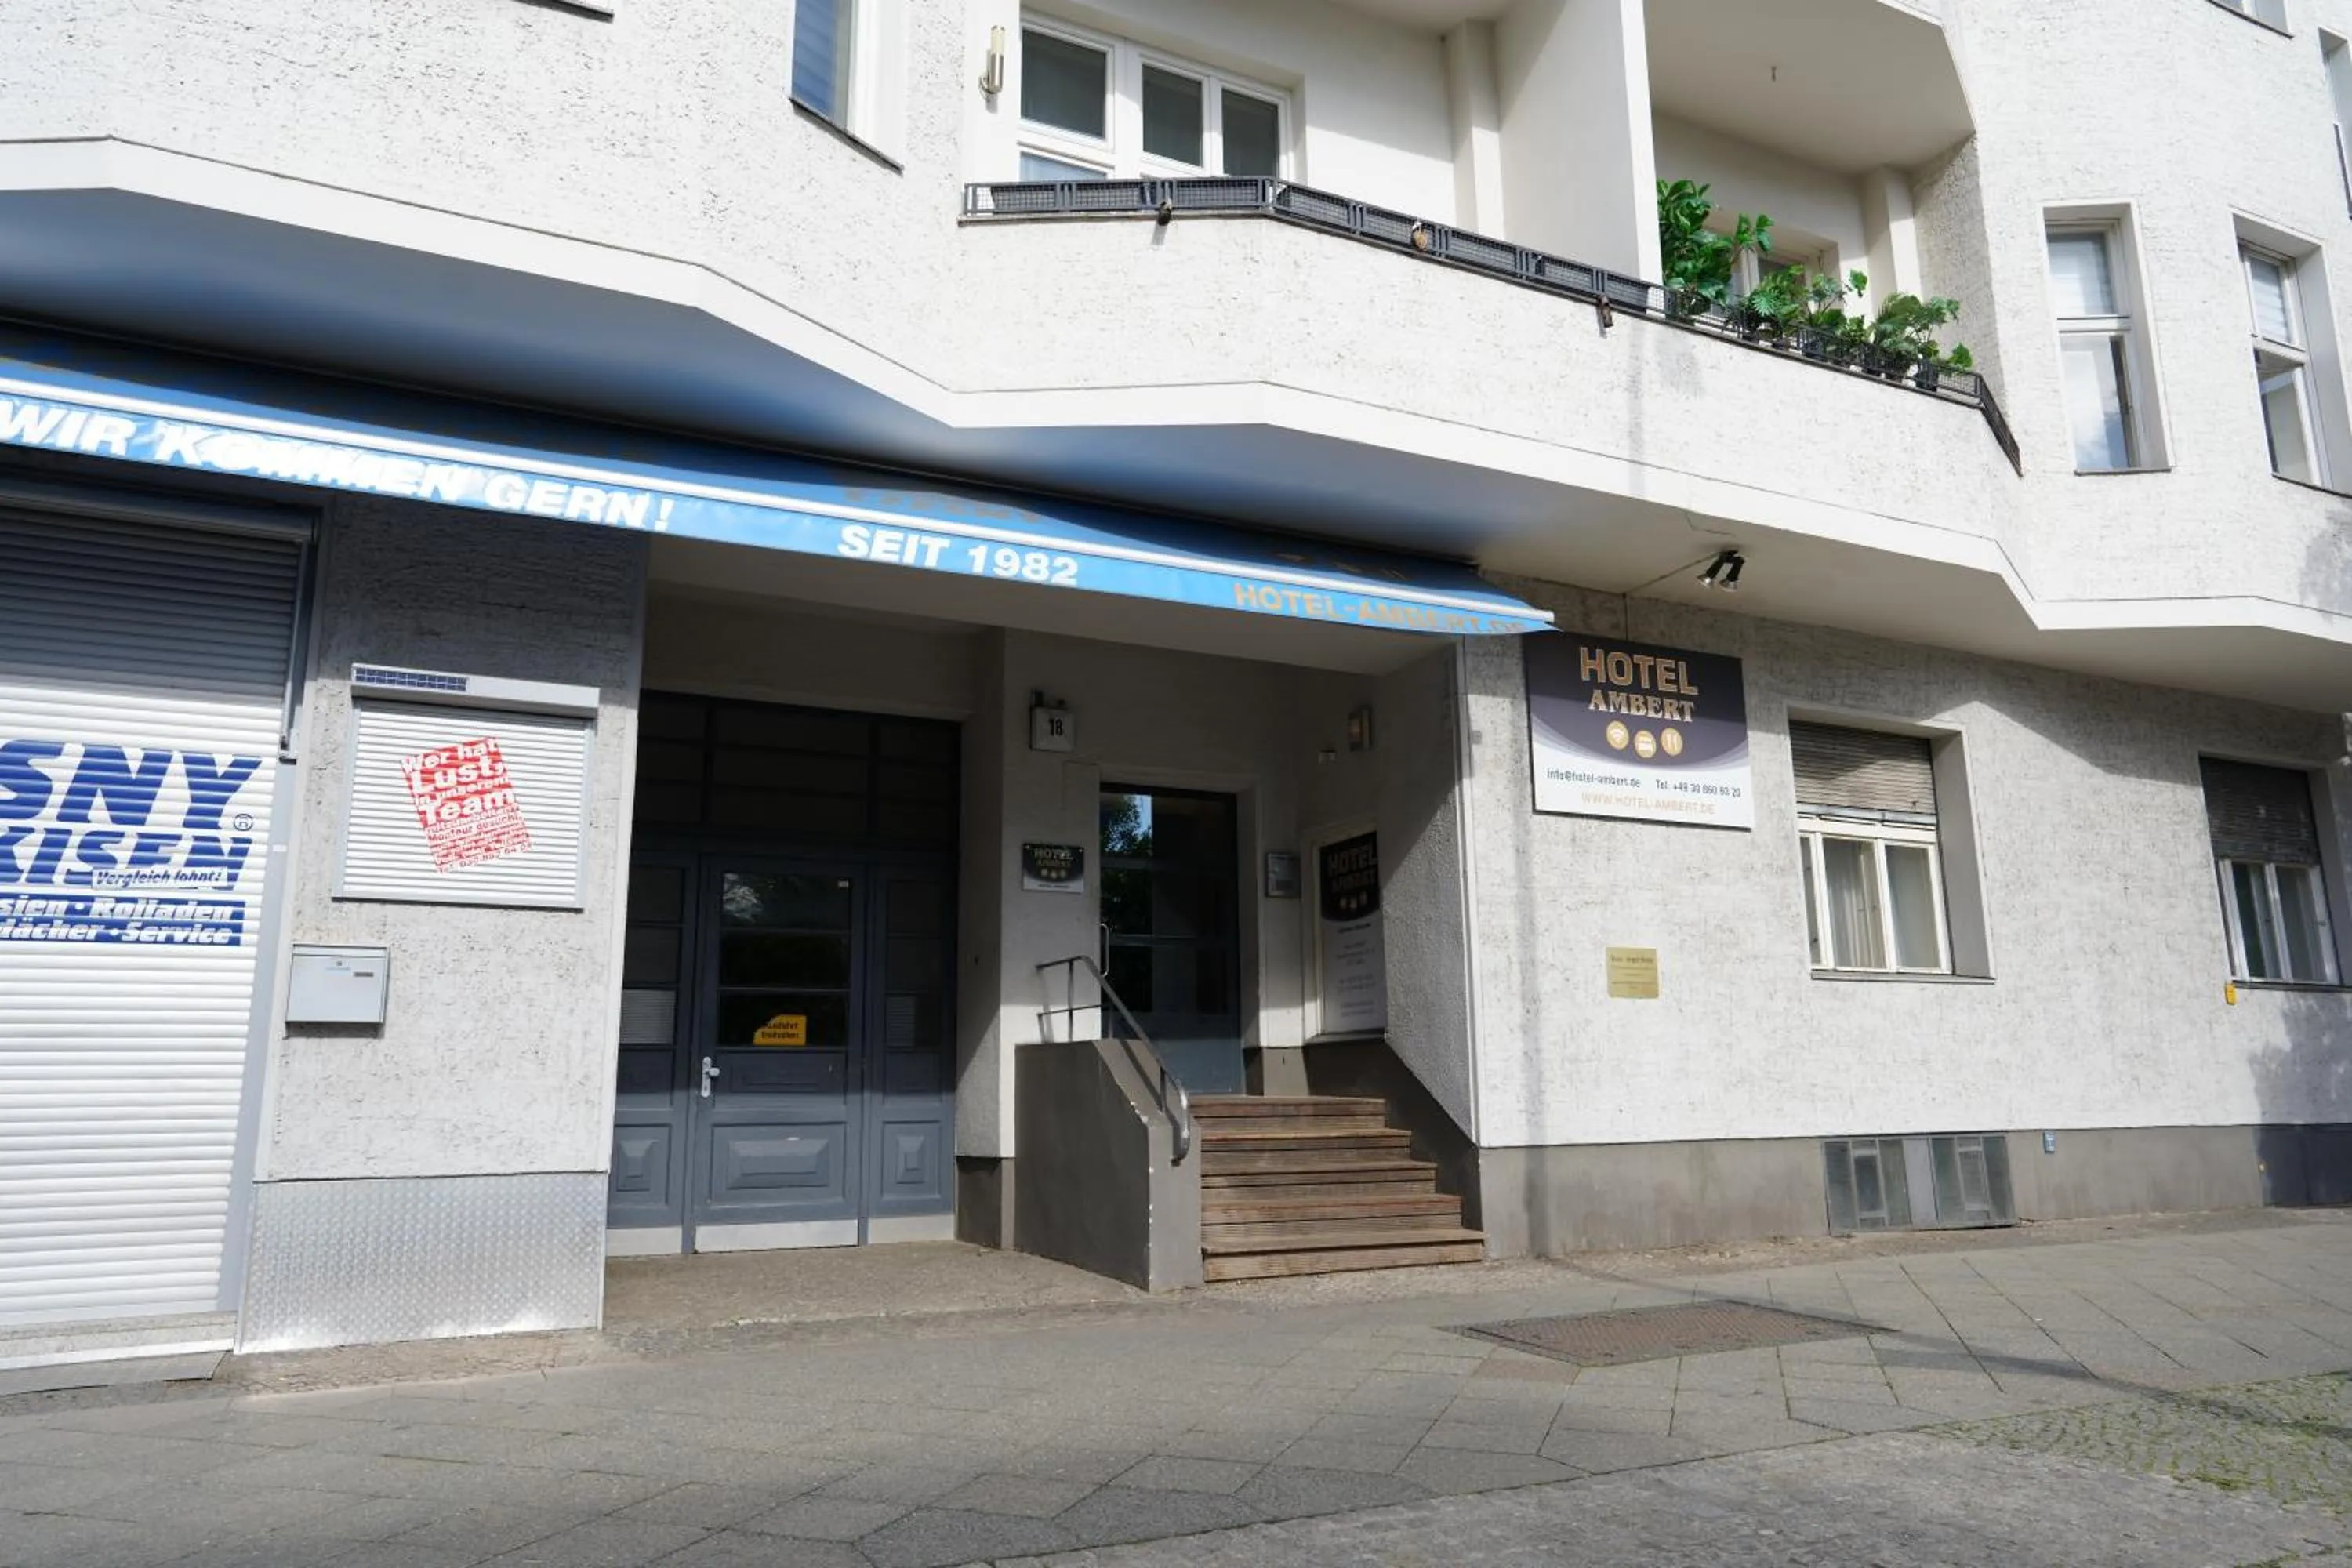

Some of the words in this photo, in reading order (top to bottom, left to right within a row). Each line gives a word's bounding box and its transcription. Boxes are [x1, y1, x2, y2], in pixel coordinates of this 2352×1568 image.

[0, 401, 136, 456] WIR
[837, 524, 950, 568] SEIT
[967, 545, 1078, 586] 1982
[1580, 646, 1699, 695] HOTEL
[1587, 689, 1693, 723] AMBERT
[1048, 717, 1063, 736] 18
[401, 750, 455, 774] Wer
[456, 738, 501, 758] hat
[0, 739, 263, 830] SNY
[410, 756, 507, 794] Lust,
[1690, 783, 1700, 793] 30
[418, 789, 515, 826] Team
[1581, 792, 1715, 815] WWW.HOTEL-AMBERT.DE
[1033, 847, 1073, 860] HOTEL
[1327, 842, 1378, 878] HOTEL
[96, 869, 171, 889] Vergleich
[174, 869, 222, 882] lohnt!
[90, 897, 234, 920] Rolladen
[122, 921, 233, 944] Service
